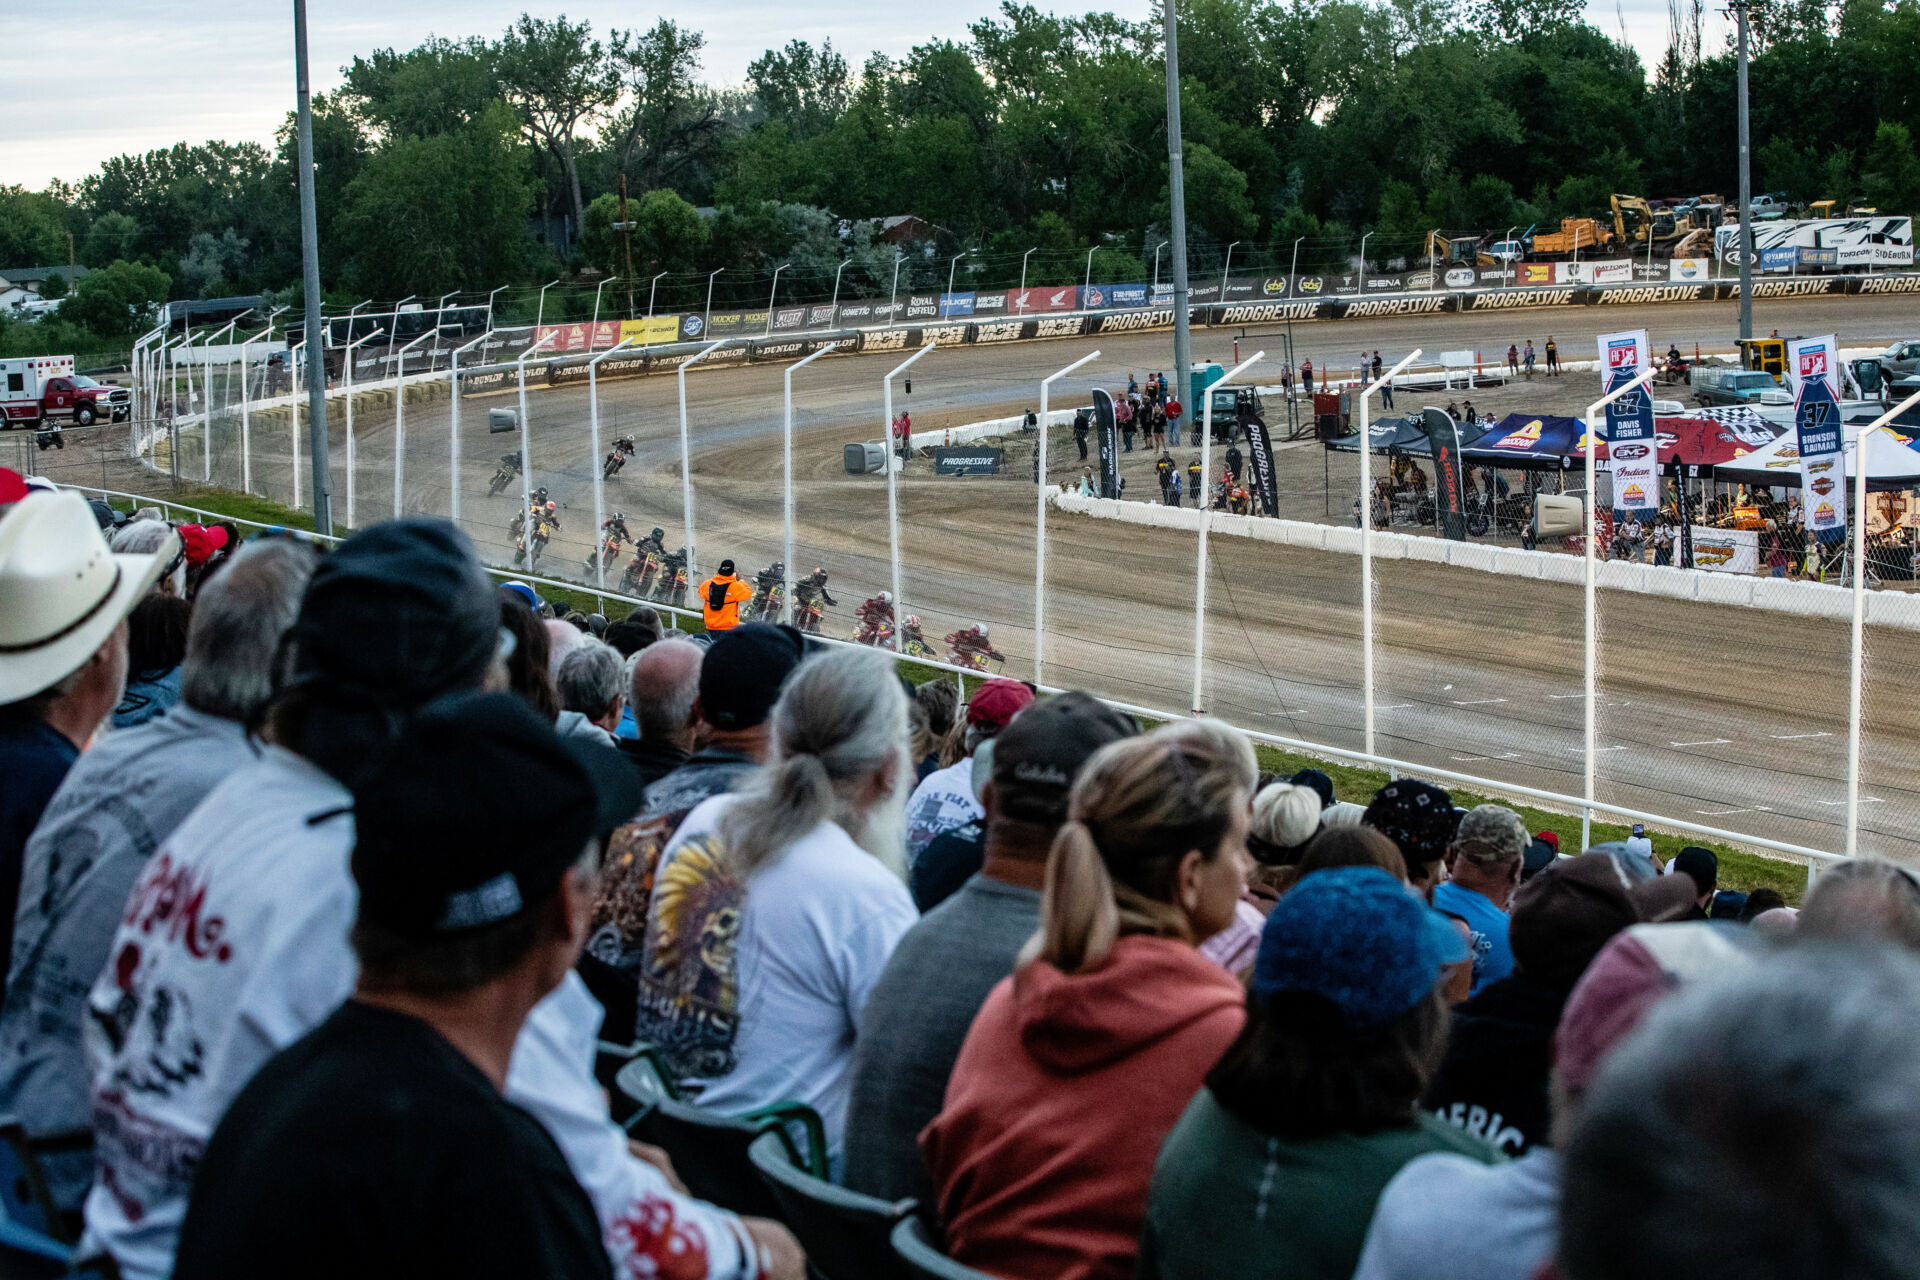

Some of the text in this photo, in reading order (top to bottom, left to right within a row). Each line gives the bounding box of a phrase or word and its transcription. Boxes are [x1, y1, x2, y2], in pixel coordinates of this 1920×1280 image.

[1771, 251, 1795, 260] YAMAHA
[1875, 248, 1911, 259] SIDEBURN
[1267, 280, 1284, 291] sbs
[1302, 279, 1320, 290] sbs
[1368, 279, 1400, 288] SENA
[1728, 278, 1832, 298] POGRESSIVE
[1194, 286, 1218, 295] Insta360
[1597, 285, 1702, 304] PROGRESSIVE
[910, 296, 934, 306] ROYAL
[1472, 290, 1574, 309] PROGRESSIVE
[842, 306, 870, 316] COMETIC
[907, 306, 936, 316] ENFIELD
[1221, 302, 1320, 323] PROGRESSIVE
[1344, 296, 1446, 318] PROGRESSIVE
[778, 311, 802, 322] KLOTZ
[978, 322, 1024, 334] VANCE
[1038, 318, 1085, 329] VANCE
[864, 330, 908, 342] VANCE
[922, 326, 966, 337] VANCE
[976, 331, 1021, 342] HINES
[1036, 326, 1080, 337] HINES
[863, 340, 906, 350] HINES
[920, 334, 964, 346] HINES
[708, 348, 746, 360] DUNLOP
[764, 344, 802, 354] DUNLOP
[607, 360, 643, 370] DUNLOP
[514, 367, 547, 378] DNLOP
[562, 366, 590, 376] DUNLO
[474, 373, 504, 385] DUNLOP
[1803, 400, 1830, 430] 37
[1618, 420, 1640, 430] DAVIS
[1616, 428, 1642, 438] FISHER
[1802, 432, 1836, 444] BRONSON
[1804, 442, 1836, 454] BAUMAN
[942, 457, 994, 466] PROGRESSIVE
[1616, 466, 1650, 478] Indian
